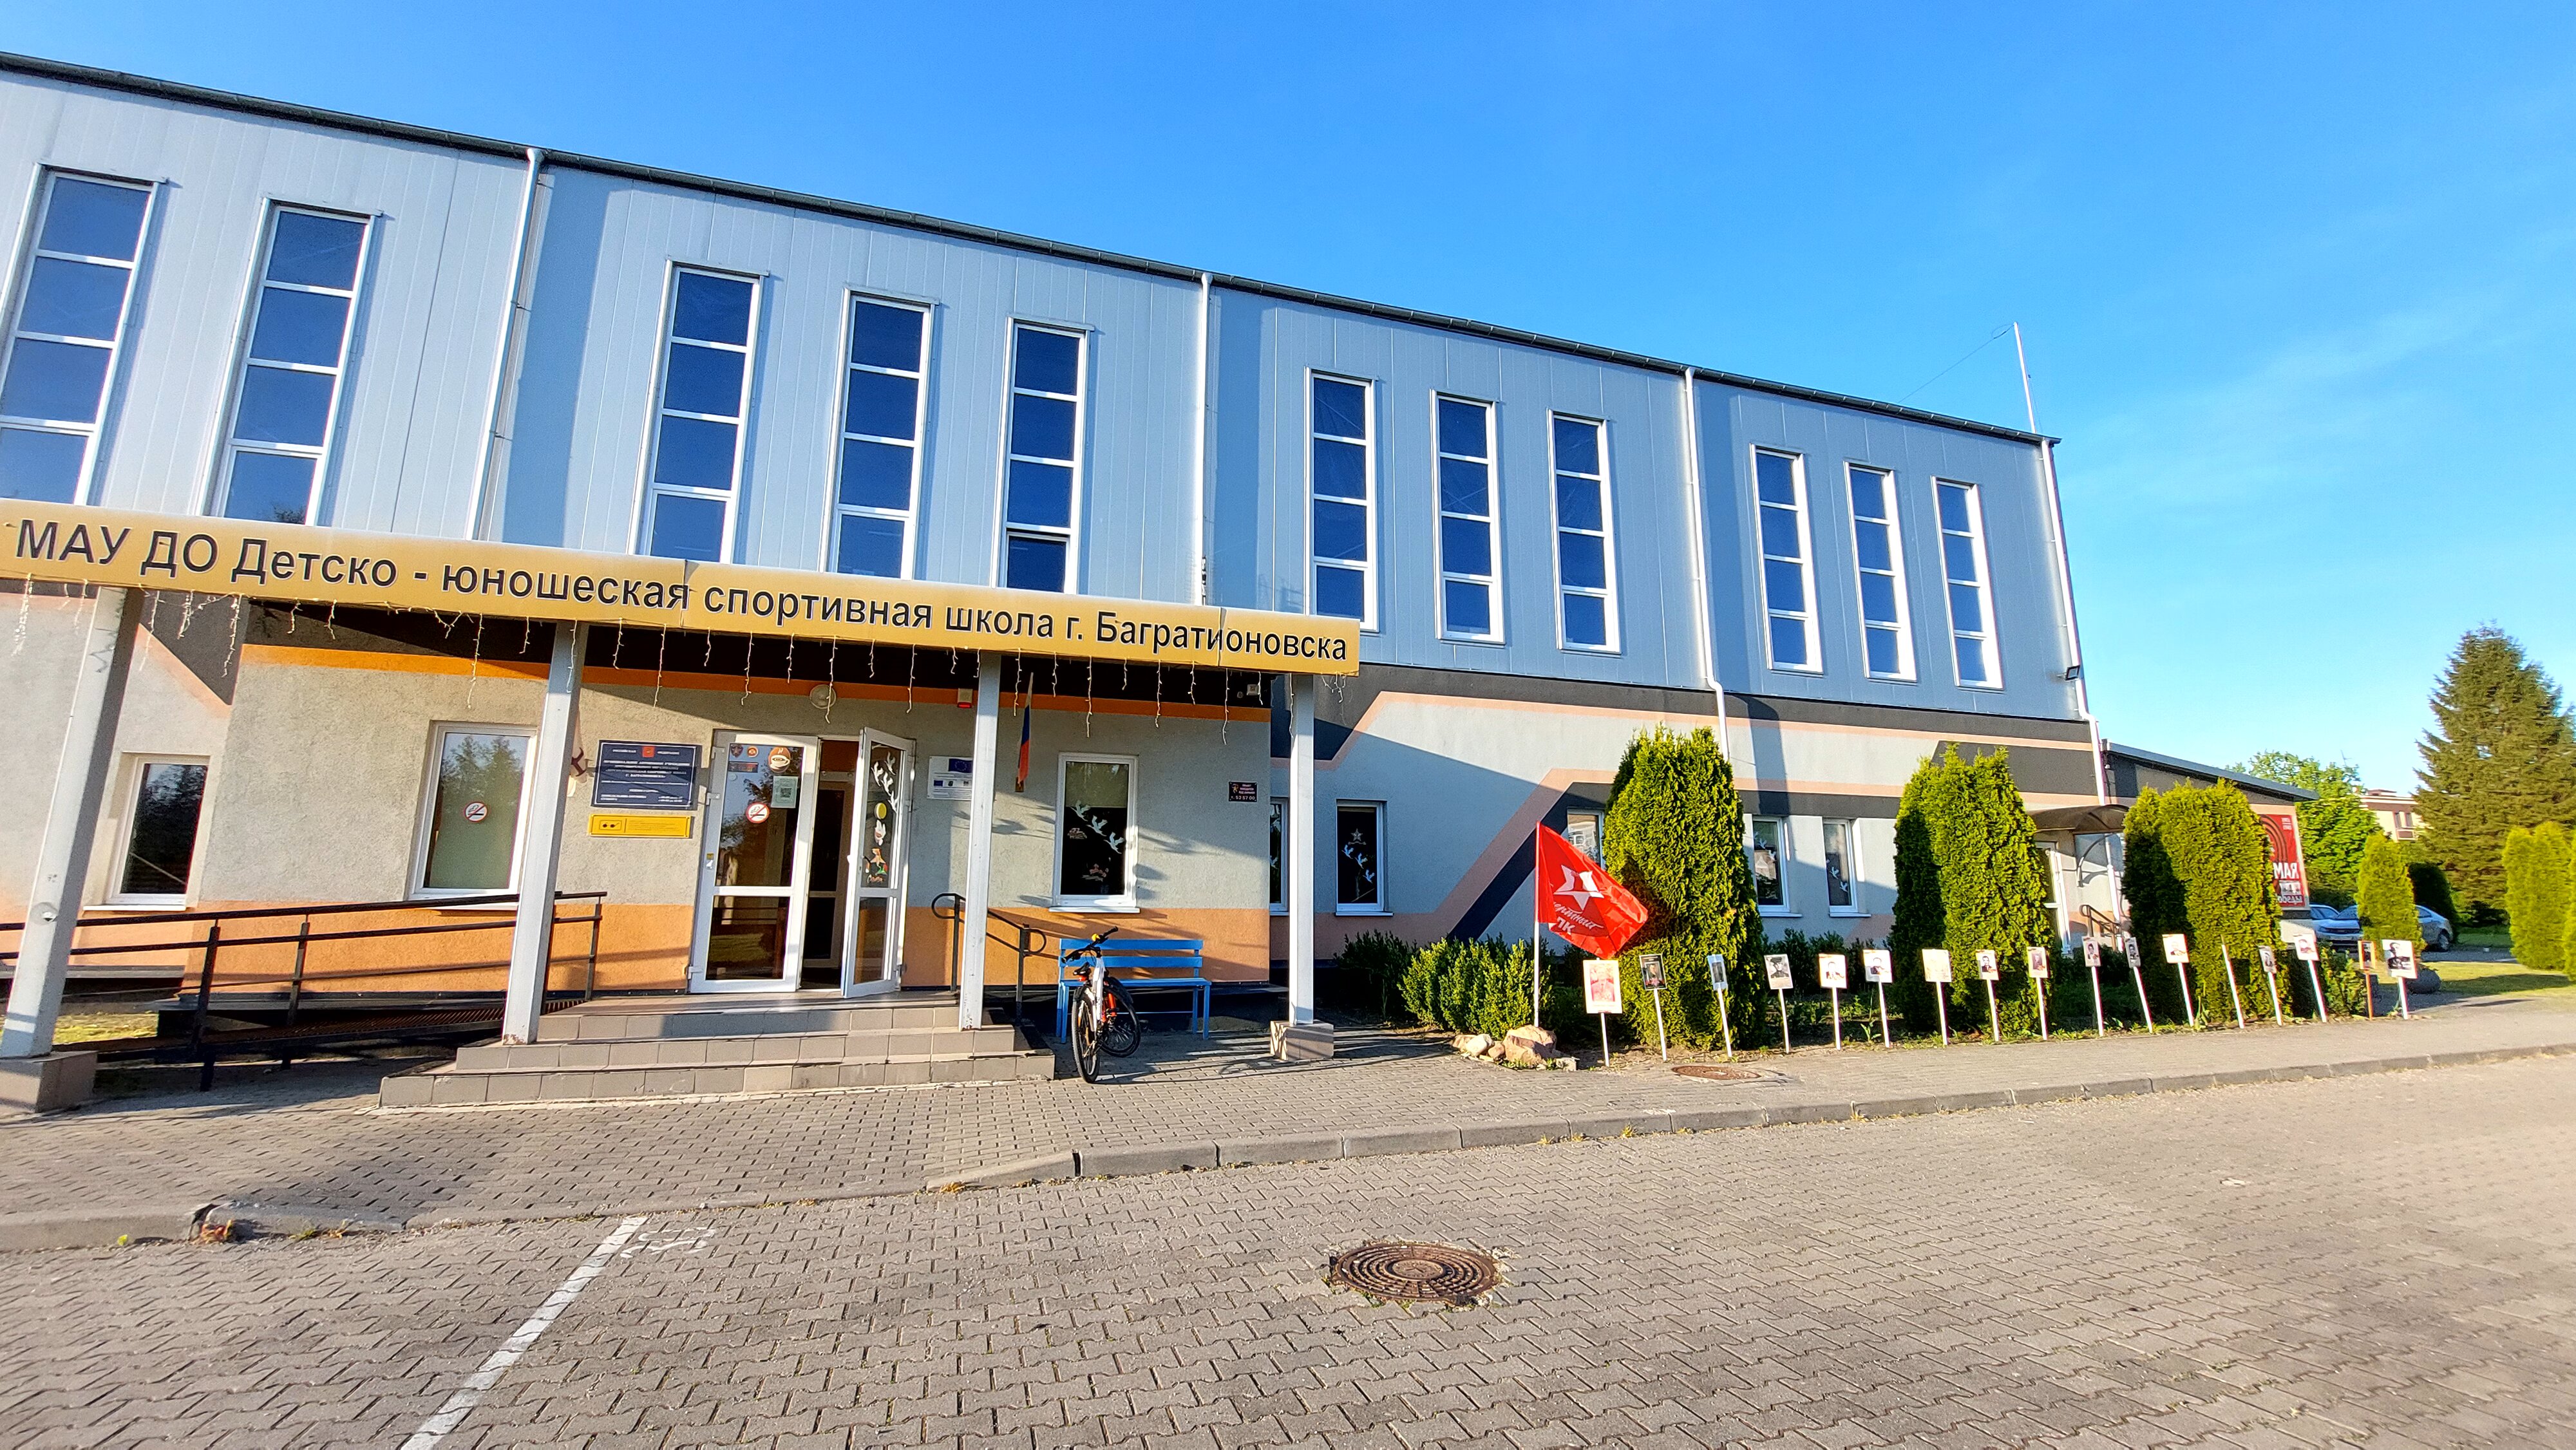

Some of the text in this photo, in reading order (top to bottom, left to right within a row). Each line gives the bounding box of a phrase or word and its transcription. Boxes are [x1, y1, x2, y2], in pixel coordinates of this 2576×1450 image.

[16, 518, 131, 565] МАУ
[140, 530, 218, 578] ДО
[231, 537, 397, 587] Детско
[442, 564, 690, 610] юношеская
[704, 586, 933, 628] спортивная
[945, 606, 1054, 638] школа
[1066, 616, 1083, 640] г.
[1097, 610, 1347, 661] Багратионовска
[2273, 862, 2300, 880] МАЯ
